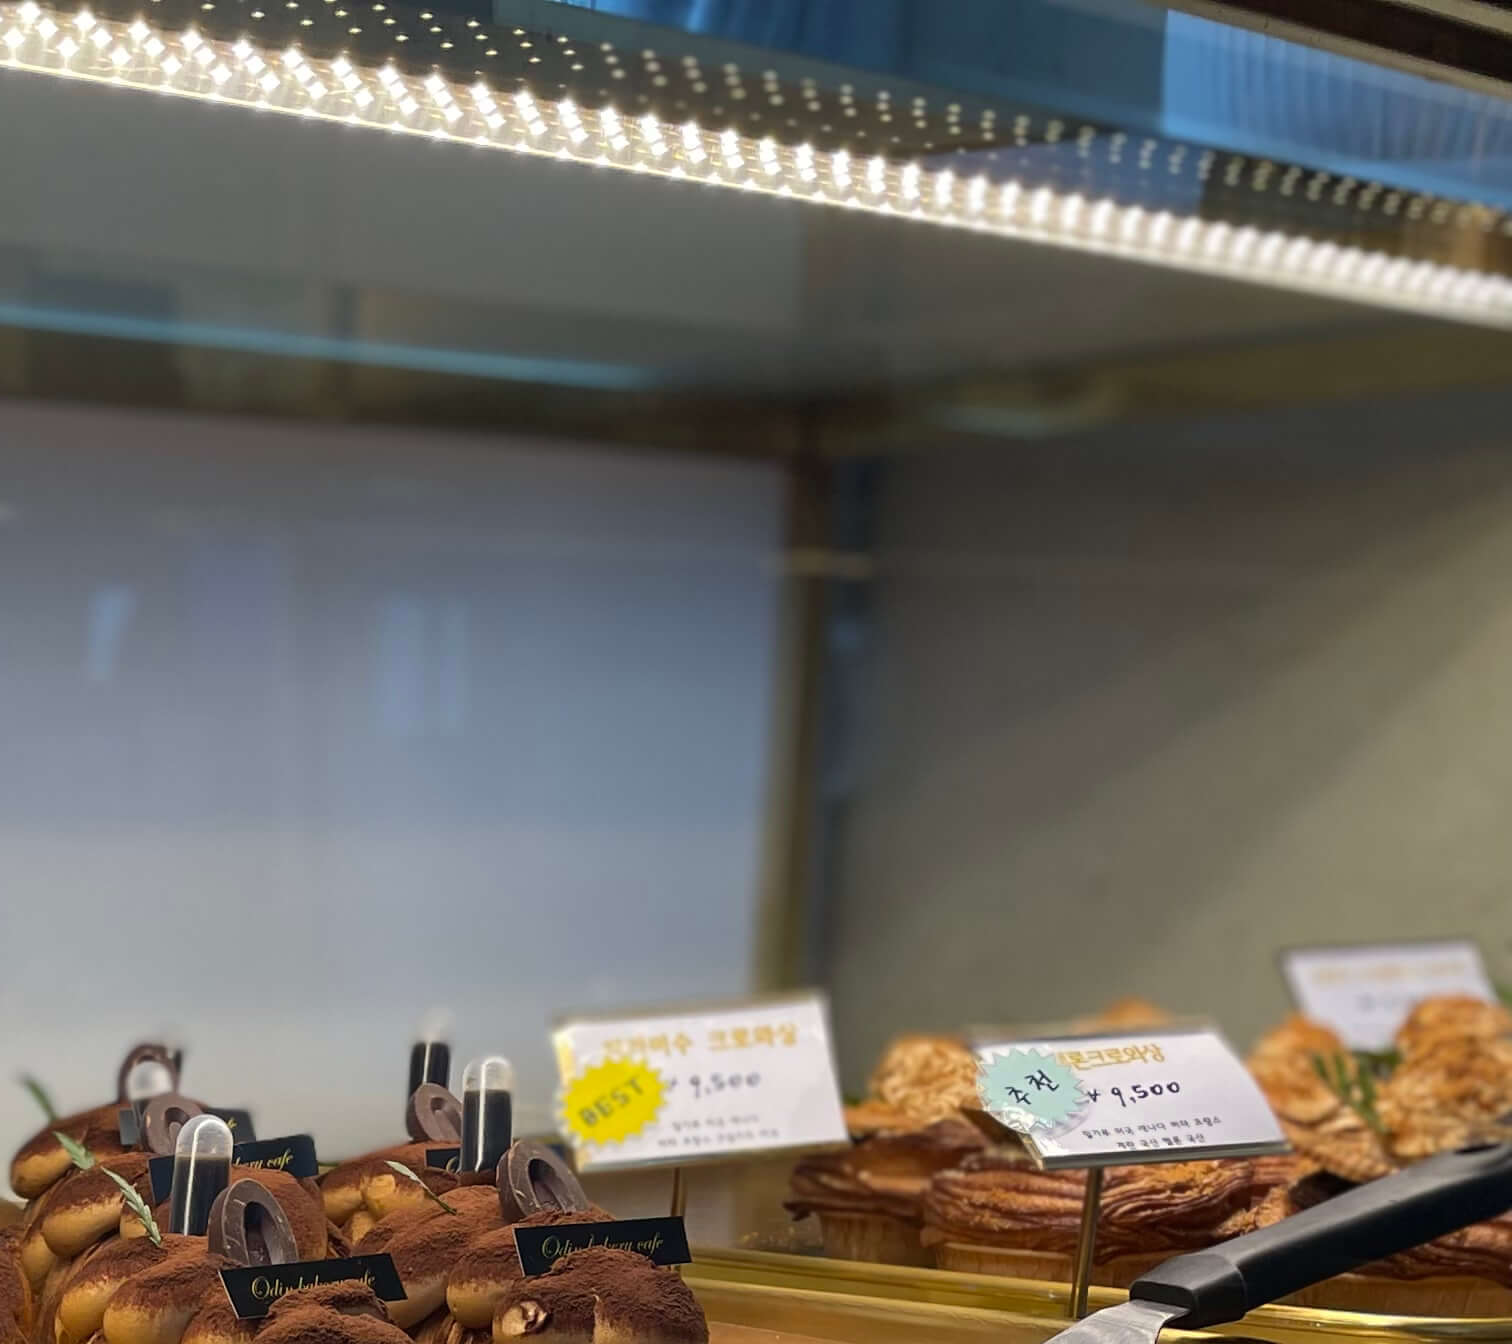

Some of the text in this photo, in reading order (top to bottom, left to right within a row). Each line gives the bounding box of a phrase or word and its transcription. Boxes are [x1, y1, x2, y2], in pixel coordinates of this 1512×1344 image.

[1056, 1043, 1165, 1071] 론크로와상
[689, 1073, 761, 1099] 9,500
[1005, 1070, 1059, 1105] 추천
[1111, 1081, 1181, 1108] 9,500
[579, 1076, 644, 1127] BEST
[266, 1148, 294, 1171] cafe
[636, 1231, 664, 1255] cafe
